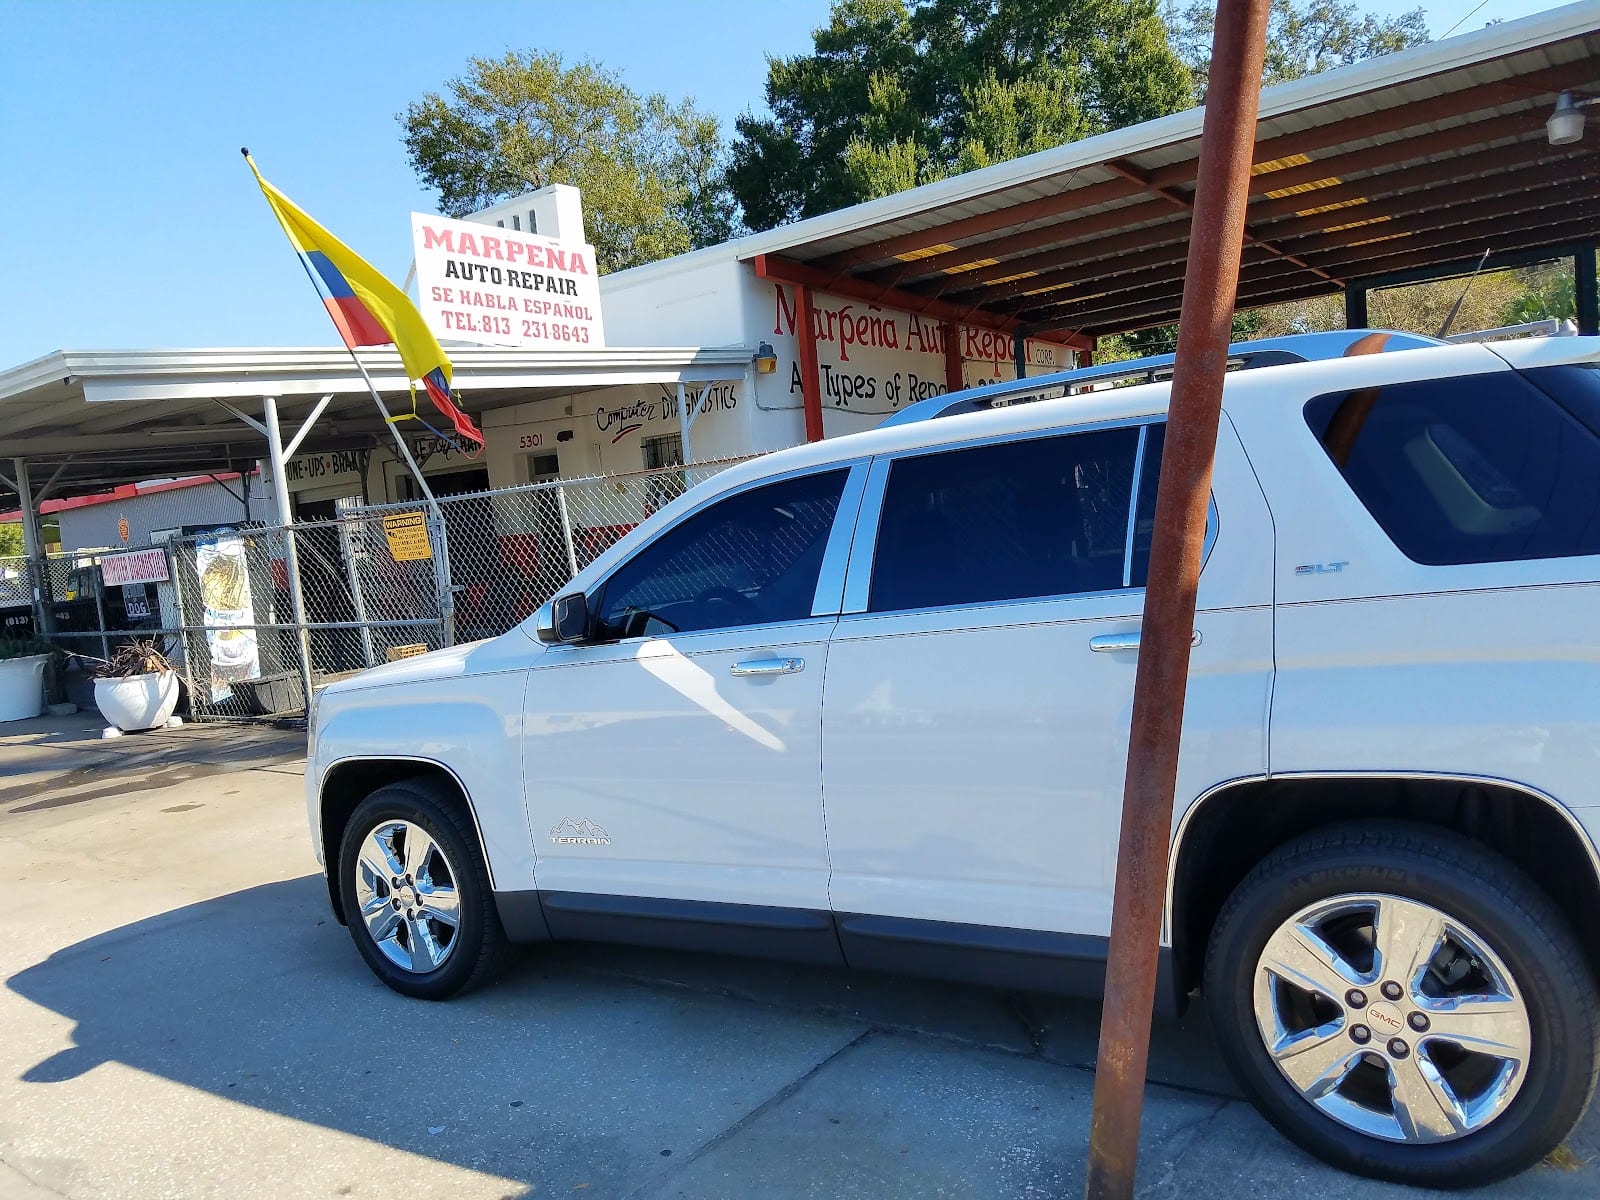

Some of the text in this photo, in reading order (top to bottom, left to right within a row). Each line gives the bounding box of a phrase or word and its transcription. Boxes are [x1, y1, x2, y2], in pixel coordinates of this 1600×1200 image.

[422, 226, 588, 275] MARPEÑA
[431, 286, 593, 321] SE HABLA ESPAÑOL
[905, 313, 947, 354] Aut
[820, 363, 877, 406] Types
[885, 372, 901, 408] of
[596, 399, 658, 431] Computer
[519, 433, 543, 449] 5301
[385, 516, 422, 529] WARNING
[128, 601, 147, 615] DOG
[550, 836, 612, 846] TERRAIN
[1369, 1008, 1401, 1029] GMC
